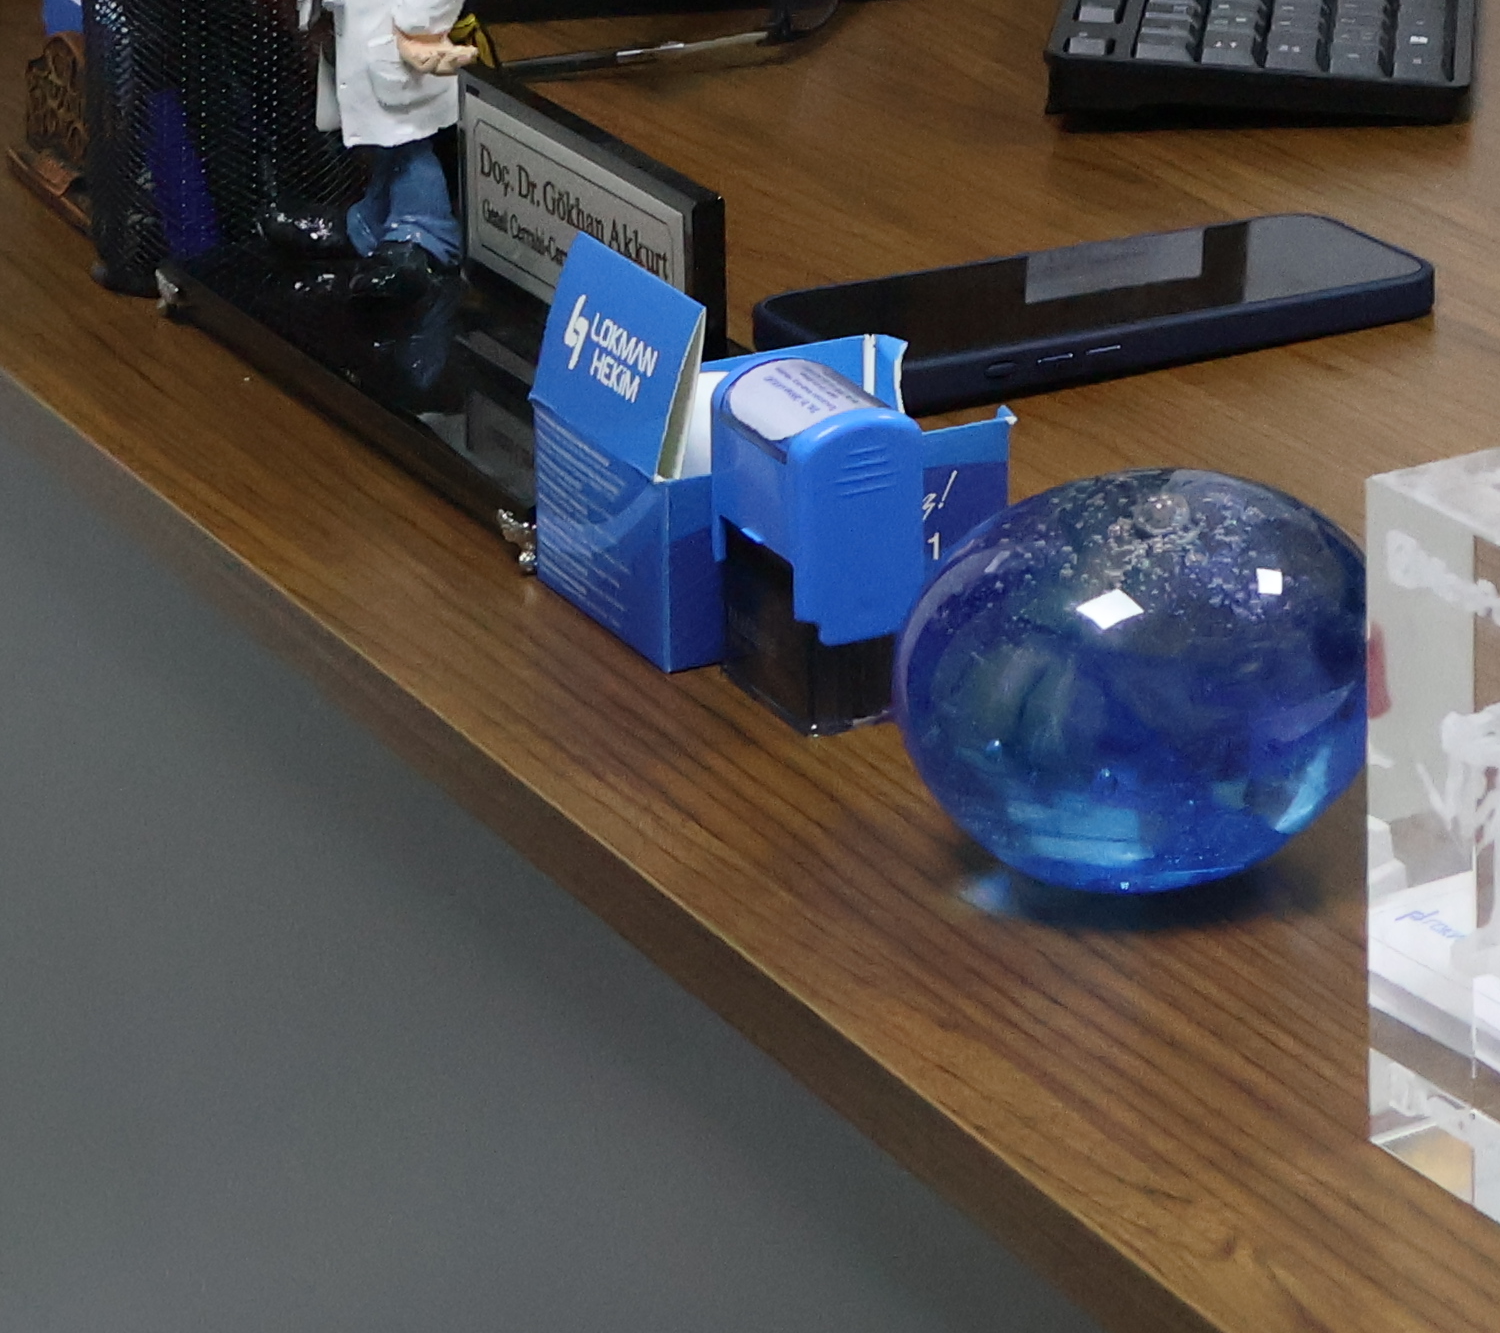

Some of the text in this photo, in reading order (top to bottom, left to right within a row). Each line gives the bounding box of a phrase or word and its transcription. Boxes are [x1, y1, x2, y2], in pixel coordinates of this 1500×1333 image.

[480, 144, 668, 280] Doç. Dr. Gökhan Akkurt
[589, 351, 641, 403] HEKİM
[591, 312, 658, 378] LOKMAN
